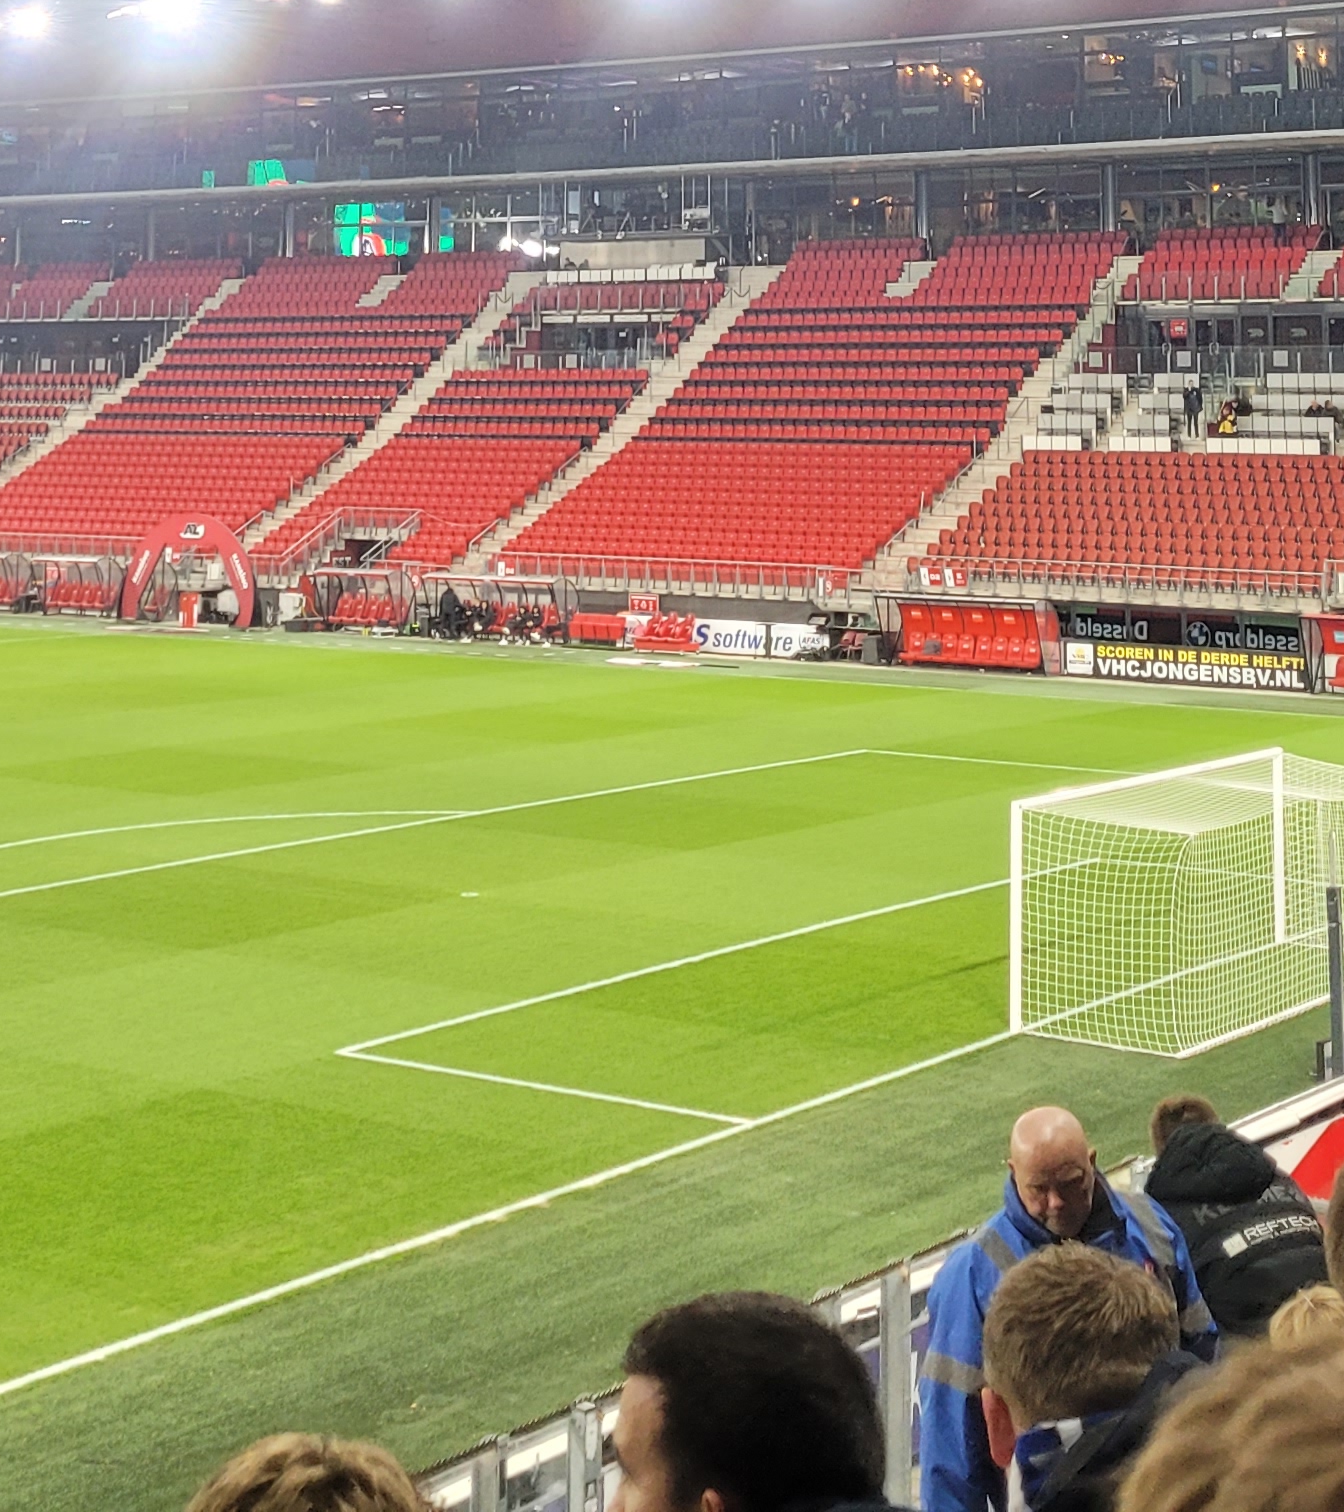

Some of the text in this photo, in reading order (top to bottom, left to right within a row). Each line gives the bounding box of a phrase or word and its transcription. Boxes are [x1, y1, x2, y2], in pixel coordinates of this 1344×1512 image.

[1096, 645, 1154, 661] SCOREN
[1158, 648, 1174, 662] IN
[1178, 649, 1198, 664] DE
[1201, 651, 1249, 667] DERDE
[1252, 654, 1305, 670] HELFT!
[1096, 657, 1305, 688] VHCJONGENSBV.NL
